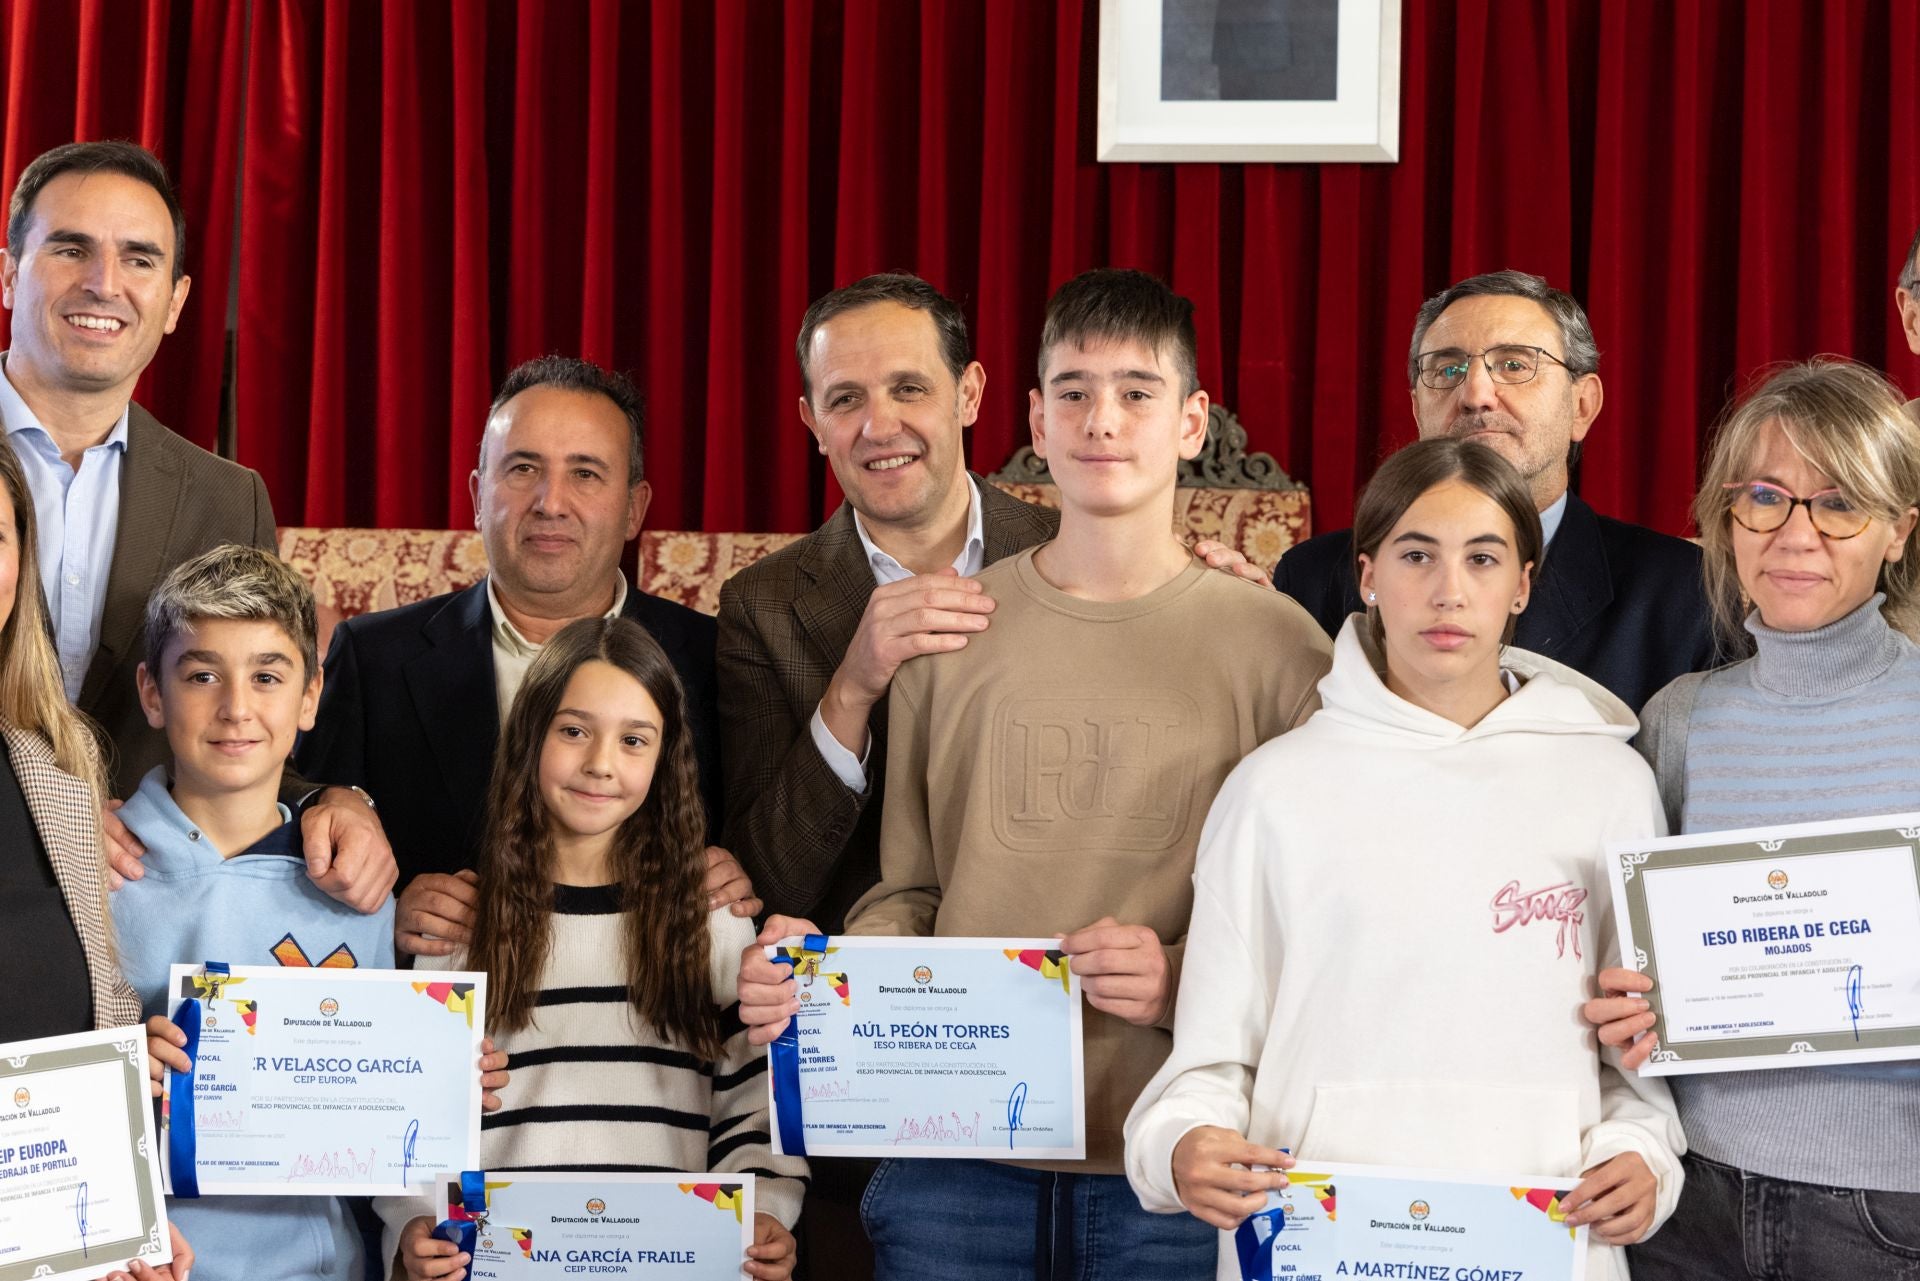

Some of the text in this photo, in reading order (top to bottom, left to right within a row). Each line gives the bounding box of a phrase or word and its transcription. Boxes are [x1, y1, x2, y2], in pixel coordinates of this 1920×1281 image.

[1702, 918, 1872, 946] IESO RIBERA DE CEGA
[1764, 943, 1812, 955] MOJADOS
[1747, 971, 1779, 979] PROVINCIAL
[879, 986, 916, 994] DIPUTACIÓN
[929, 986, 967, 994] VALLADOLID
[283, 1017, 372, 1028] DIPUTACIÓN DE VALLADOLID
[890, 1021, 937, 1038] PEÓN
[942, 1025, 1010, 1038] TORRES
[802, 1045, 820, 1054] RAÚL
[873, 1041, 976, 1050] IESO RIBERA DE CEGA
[272, 1058, 352, 1072] VELASCO
[357, 1057, 423, 1073] GARCÍA
[294, 1075, 357, 1084] CEIP EUROPA
[211, 1083, 237, 1091] GARCÍA
[19, 1139, 67, 1161] EUROPA
[31, 1163, 40, 1174] DE
[42, 1156, 77, 1171] PORTILLO
[601, 1216, 640, 1224] VALLADOLID
[1370, 1219, 1466, 1234] DIPUTACIÓN DE VALLADOLID
[566, 1248, 632, 1263] GARCÍA
[638, 1251, 696, 1264] FRAILE
[473, 1270, 497, 1278] VOCAL
[564, 1265, 627, 1273] CEIP EUROPA
[1353, 1261, 1451, 1281] MARTÍNEZ
[1456, 1265, 1523, 1281] GÓMEZ
